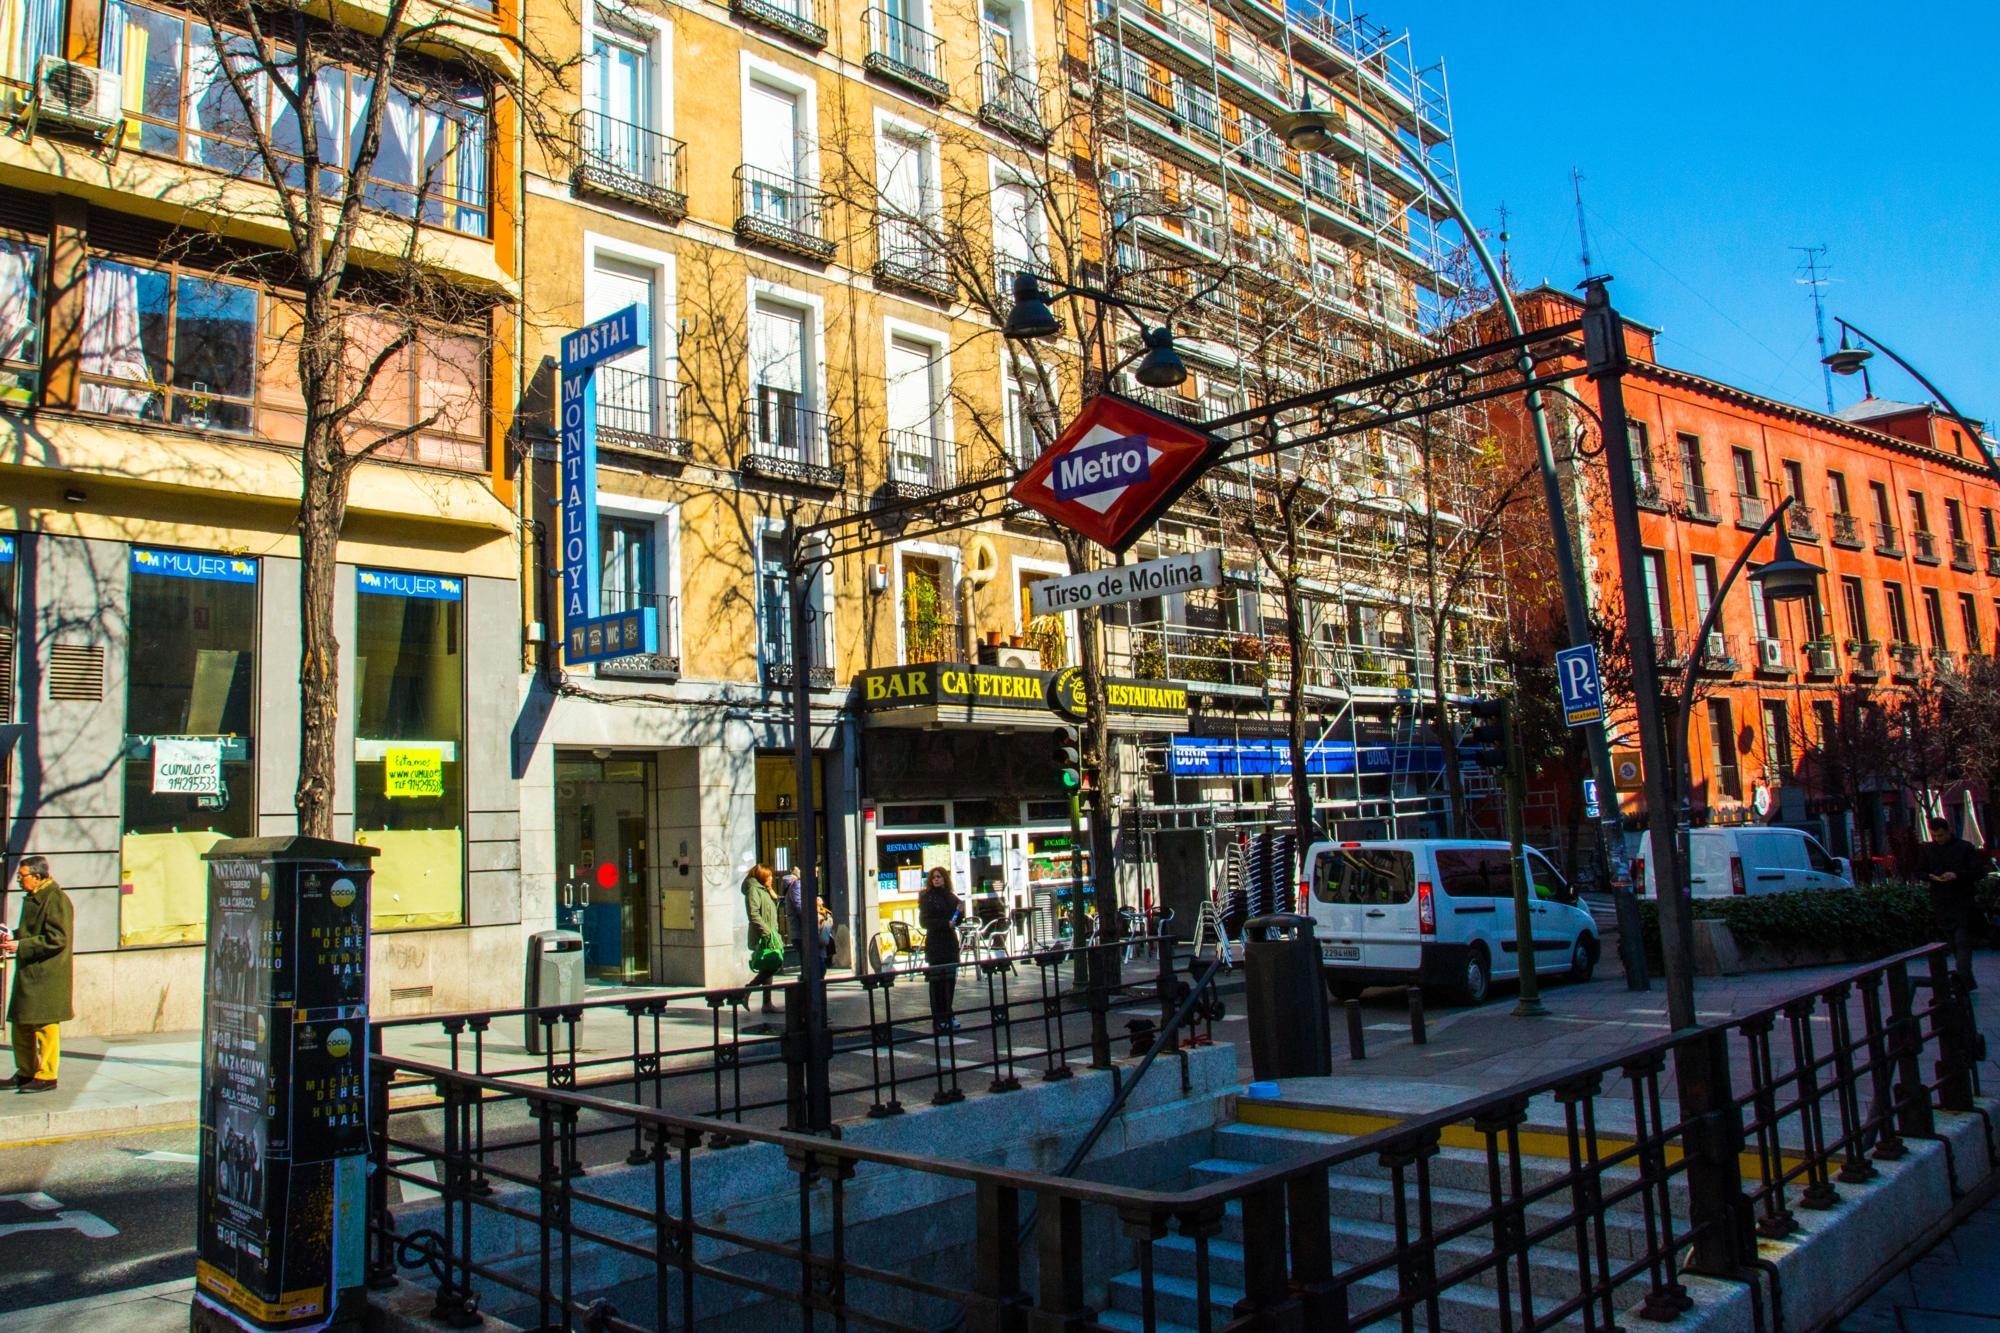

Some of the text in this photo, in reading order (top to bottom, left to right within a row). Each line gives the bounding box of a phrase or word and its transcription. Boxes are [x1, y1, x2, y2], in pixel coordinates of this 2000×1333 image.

[568, 316, 630, 364] HOSTAL
[1059, 448, 1142, 491] Metro
[563, 374, 585, 617] MONTALOYA
[163, 555, 227, 576] MUJER
[383, 575, 438, 595] MUJER
[1043, 563, 1203, 608] Tirso de Molina
[572, 624, 620, 651] TV WC
[866, 671, 930, 701] BAR
[942, 671, 1043, 700] CAFETERIA
[1563, 656, 1589, 701] P
[1106, 683, 1187, 710] RESTAURANTE
[1175, 748, 1210, 766] BBVA
[1366, 749, 1391, 766] BBVA
[168, 775, 218, 792] 914295533
